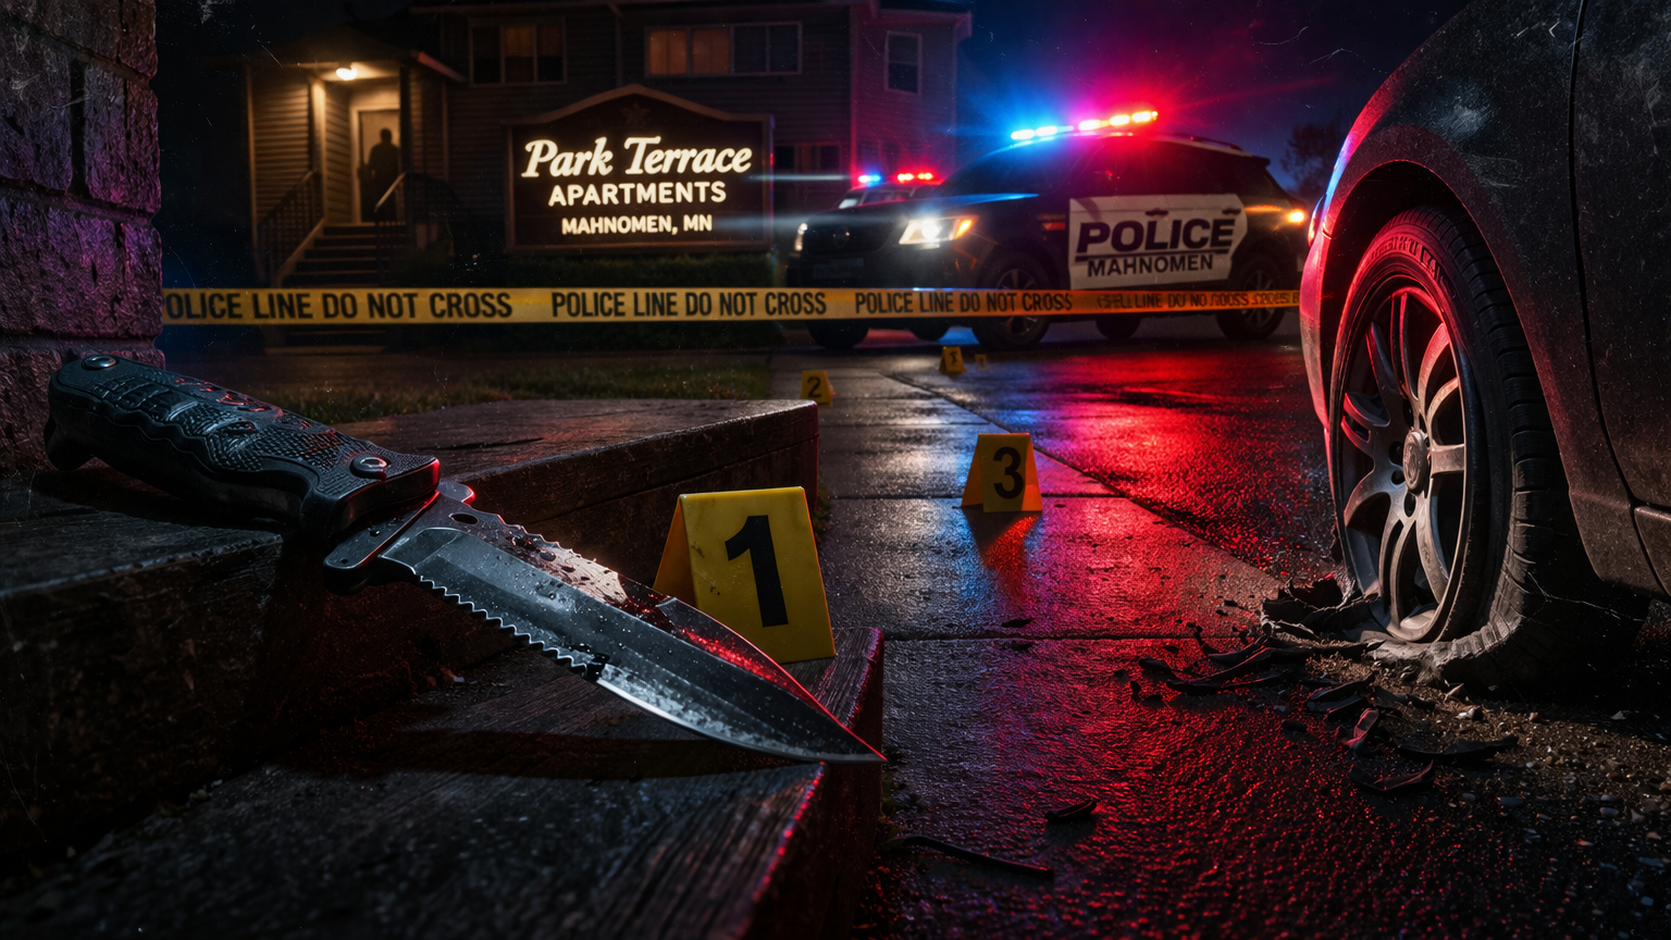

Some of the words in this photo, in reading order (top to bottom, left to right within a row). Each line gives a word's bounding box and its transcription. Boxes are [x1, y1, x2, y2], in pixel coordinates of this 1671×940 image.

[521, 136, 613, 178] Park
[624, 135, 753, 175] Terrace
[548, 181, 727, 207] APARTMENTS
[562, 214, 678, 235] MAHNOMEN,
[683, 213, 713, 232] MN
[1076, 218, 1236, 253] POLICE
[1087, 254, 1213, 278] MAHNOMEN
[164, 292, 242, 319] OLICE
[252, 293, 313, 319] LINE
[322, 292, 357, 319] DO
[368, 292, 418, 319] NOT
[429, 292, 513, 318] CROSS
[551, 291, 626, 318] POLICE
[633, 292, 678, 317] LINE
[685, 291, 712, 317] DO
[719, 291, 758, 316] NOT
[765, 290, 827, 316] CROSS
[854, 292, 913, 314] POLICE
[919, 292, 954, 313] LINE
[960, 292, 981, 313] DO
[987, 292, 1018, 312] NOT
[1022, 291, 1073, 312] CROSS
[807, 376, 822, 398] 2
[992, 446, 1025, 499] 3
[724, 514, 789, 628] 1
